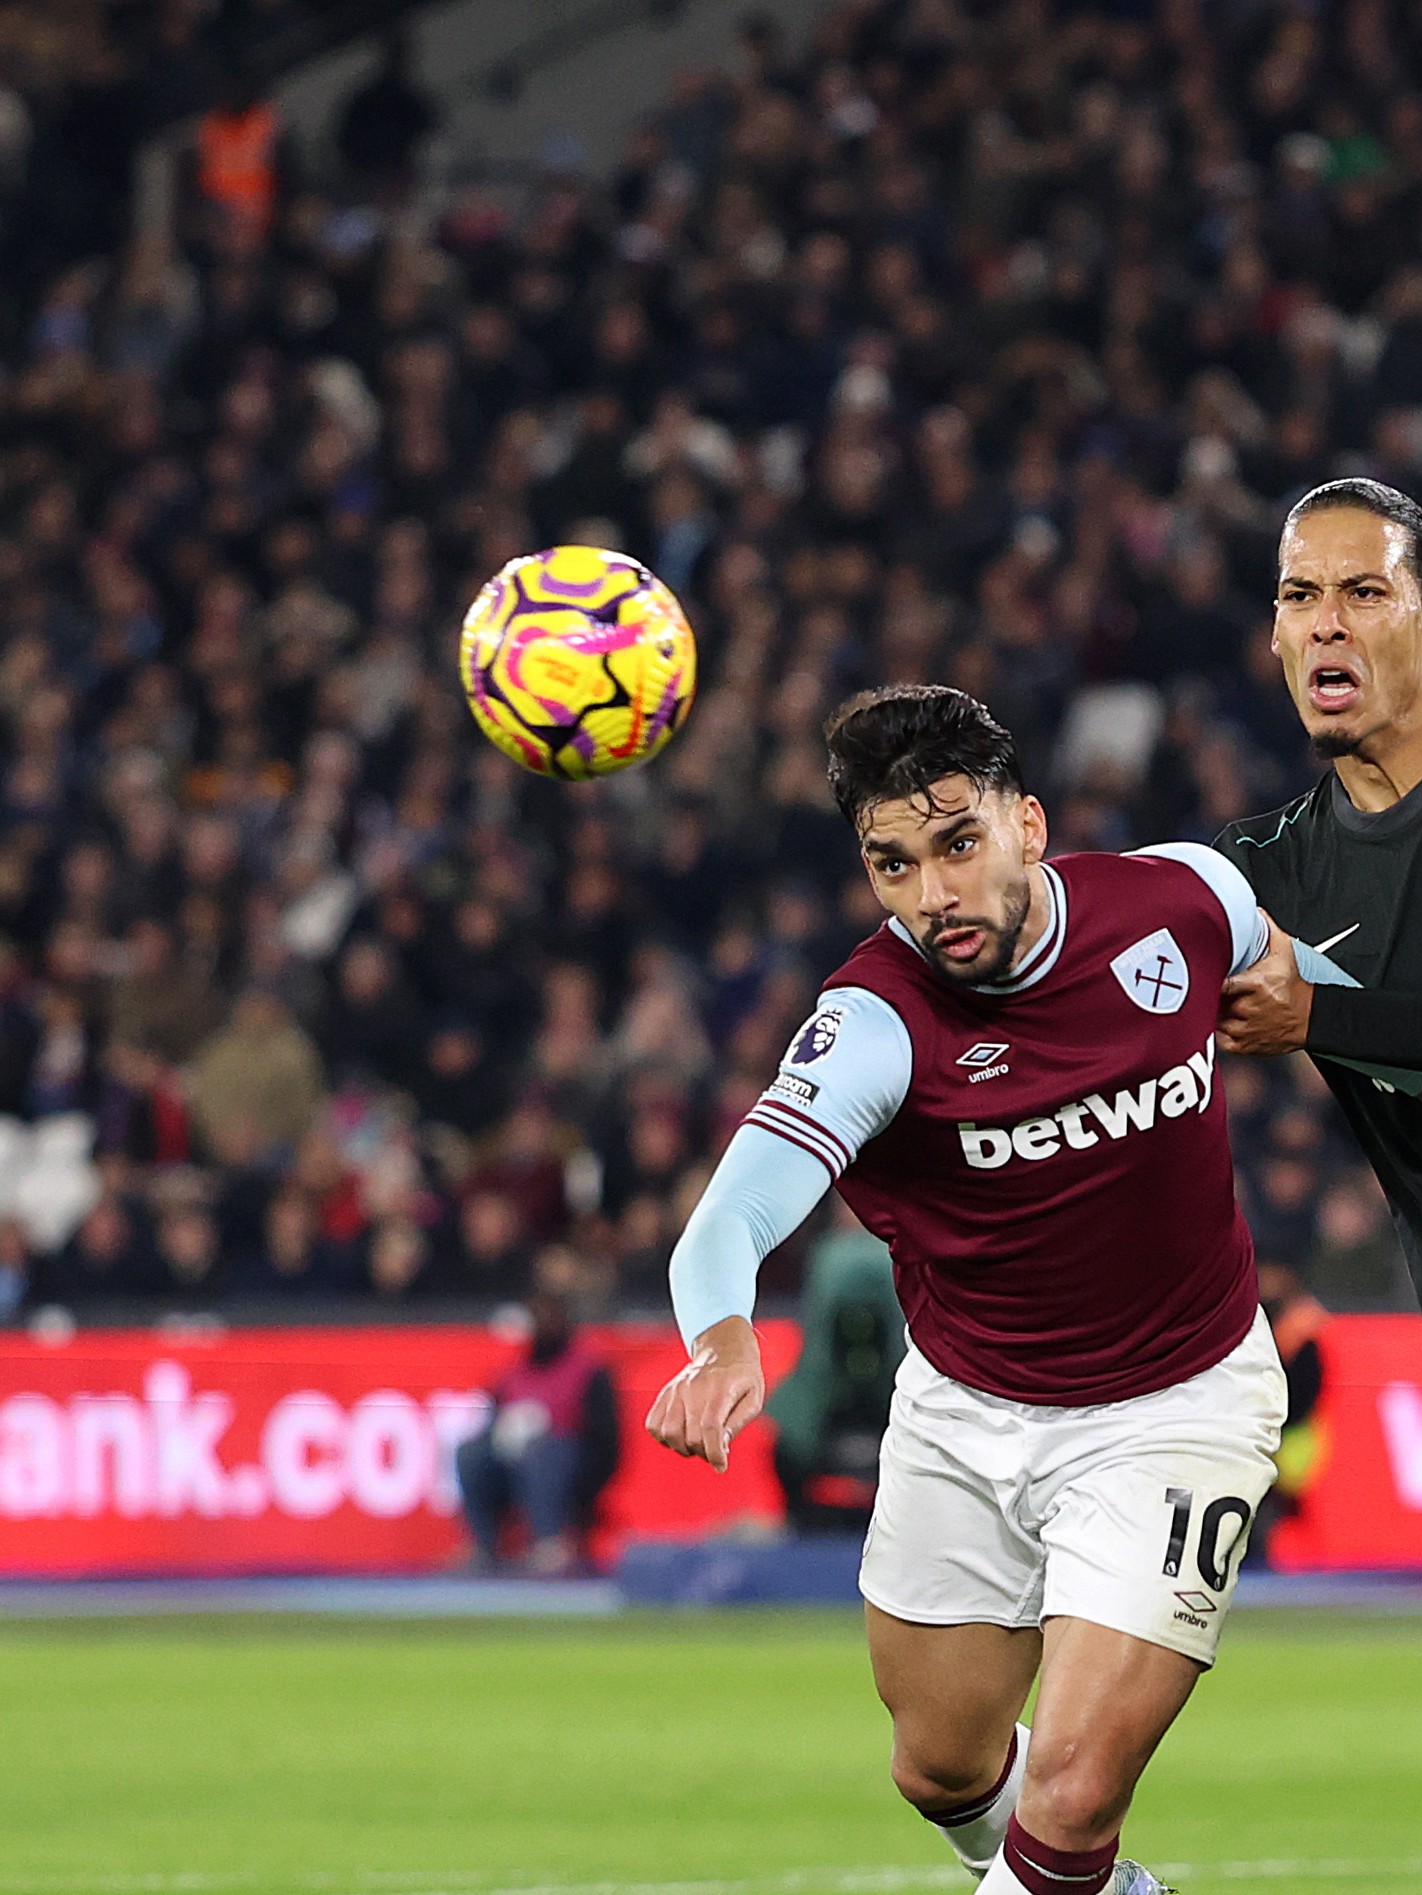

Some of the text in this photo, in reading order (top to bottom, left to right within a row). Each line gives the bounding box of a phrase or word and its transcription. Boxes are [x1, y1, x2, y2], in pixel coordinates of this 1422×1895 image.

[957, 1032, 1215, 1170] betway
[968, 1062, 1010, 1083] umbro
[1162, 1487, 1251, 1593] 10
[1173, 1609, 1208, 1630] umbro
